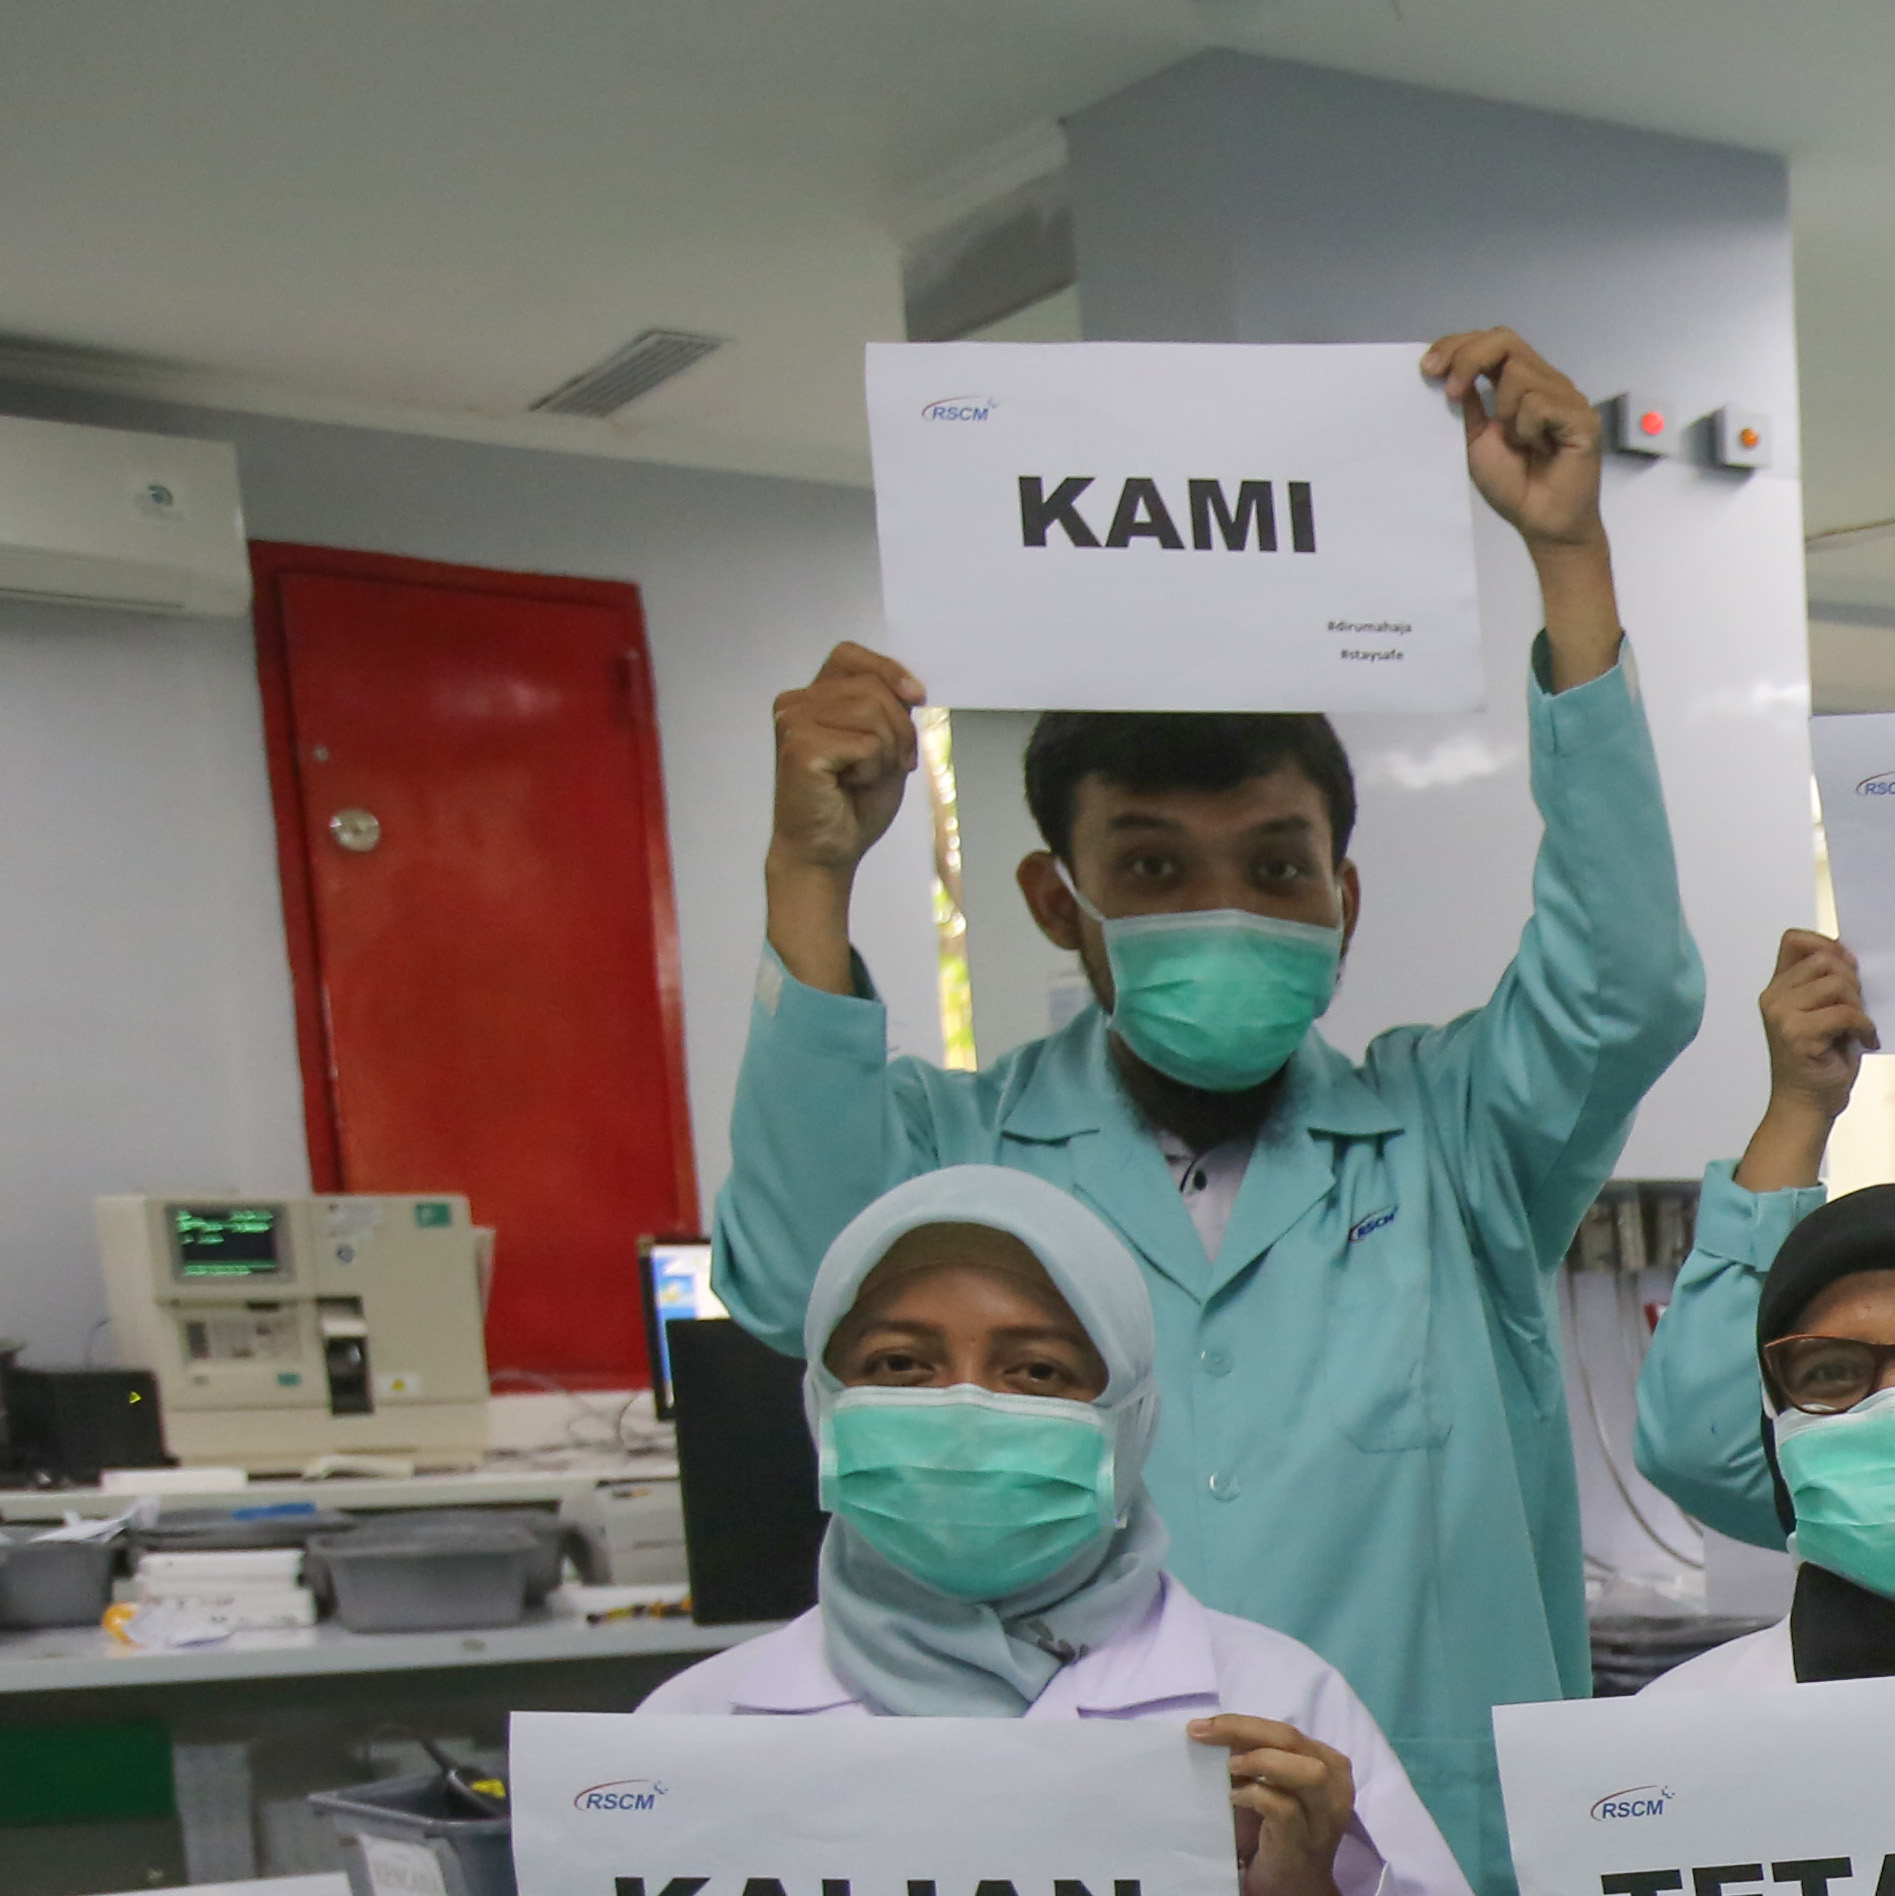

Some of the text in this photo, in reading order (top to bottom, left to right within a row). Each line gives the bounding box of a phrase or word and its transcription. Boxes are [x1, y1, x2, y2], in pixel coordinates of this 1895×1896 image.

[932, 405, 989, 422] RSCM
[1017, 475, 1317, 553] KAMI
[587, 1791, 656, 1811] RSCM
[1601, 1798, 1663, 1819] RSCM
